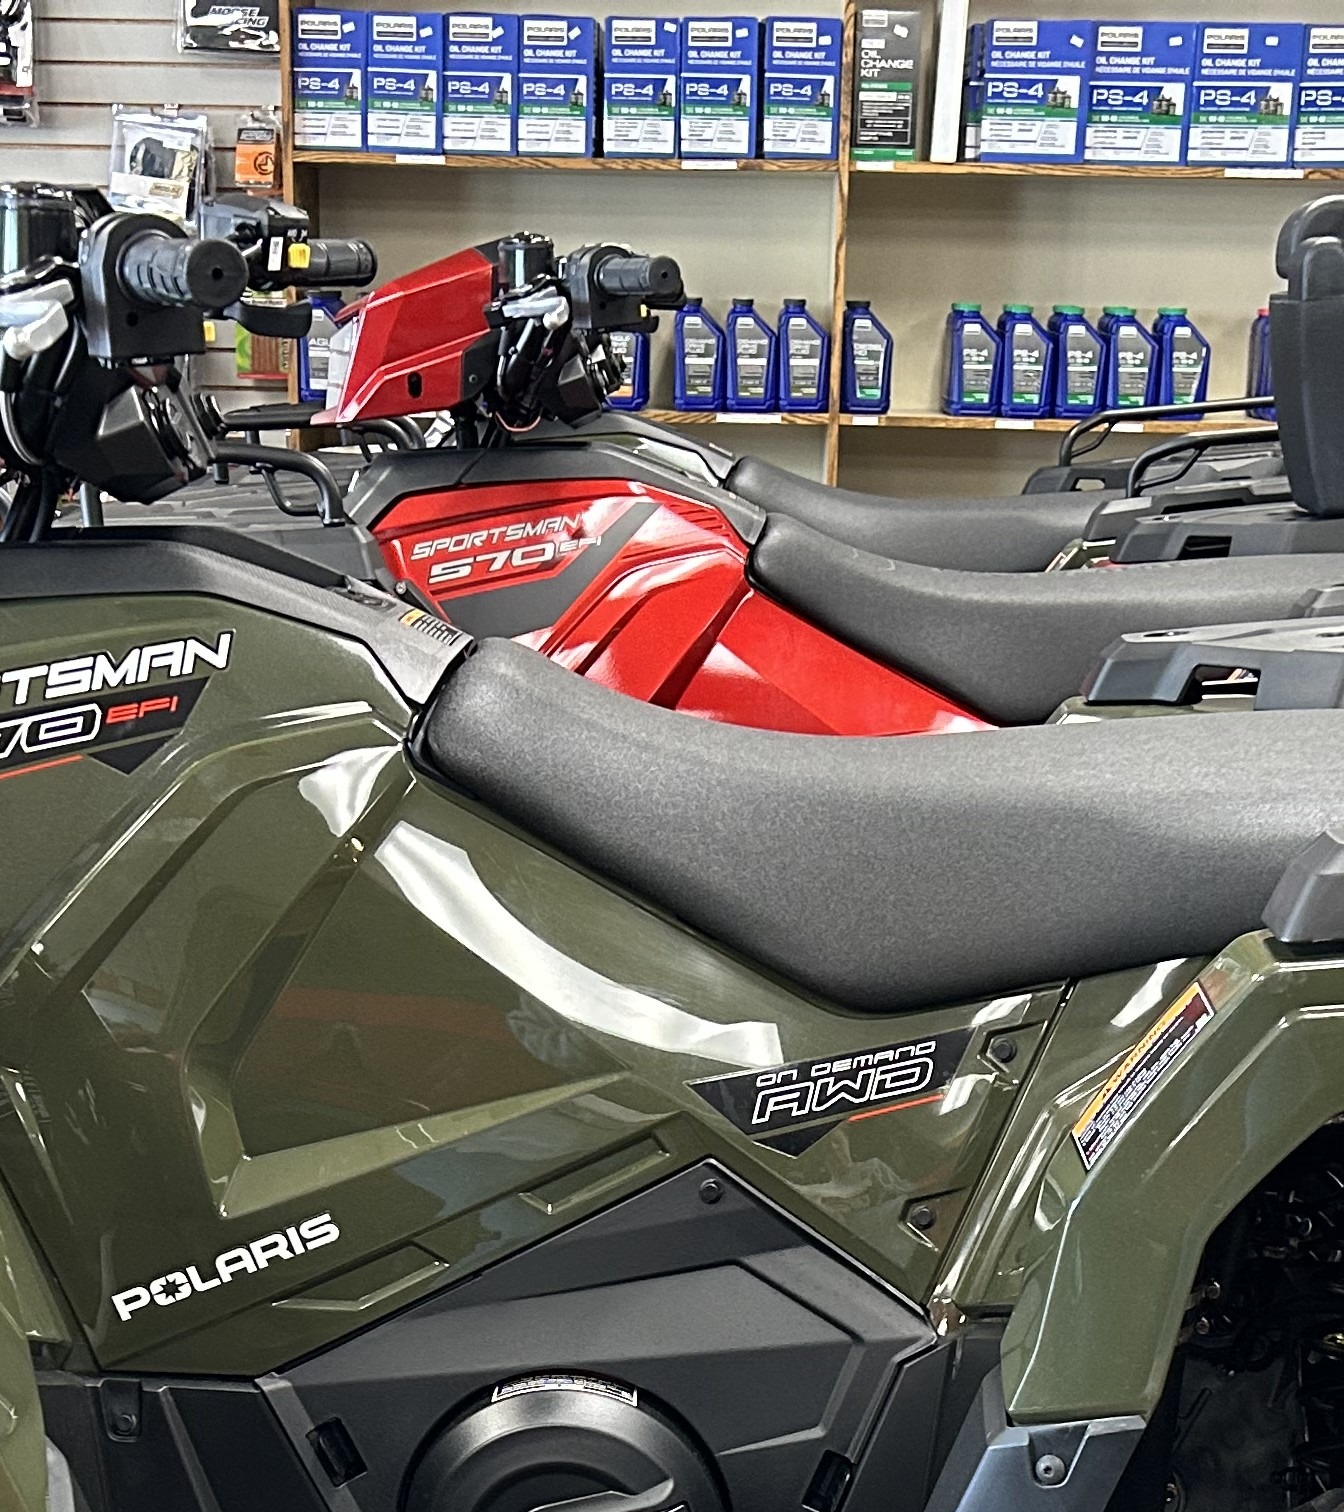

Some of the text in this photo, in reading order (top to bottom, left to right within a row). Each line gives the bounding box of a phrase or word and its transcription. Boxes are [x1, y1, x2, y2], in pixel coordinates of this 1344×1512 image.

[232, 16, 267, 26] CING
[861, 50, 881, 59] OIL
[861, 59, 914, 69] CHANGE
[860, 69, 881, 77] KIT
[298, 77, 340, 90] PS-4
[373, 78, 415, 91] PS-4
[448, 81, 489, 94] PS-4
[523, 83, 565, 96] PS-4
[611, 83, 654, 96] PS-4
[686, 83, 728, 96] PS-4
[770, 83, 812, 96] PS-4
[987, 81, 1044, 98] PS-4
[1092, 89, 1149, 106] PS-4
[1200, 89, 1256, 106] PS-4
[411, 514, 582, 561] SPORTSMAN
[427, 533, 603, 585] 570 EFI
[105, 696, 178, 727] EFI
[755, 1041, 937, 1088] ON DEMAND
[752, 1057, 935, 1125] AWD
[111, 1212, 340, 1321] POLARIS
